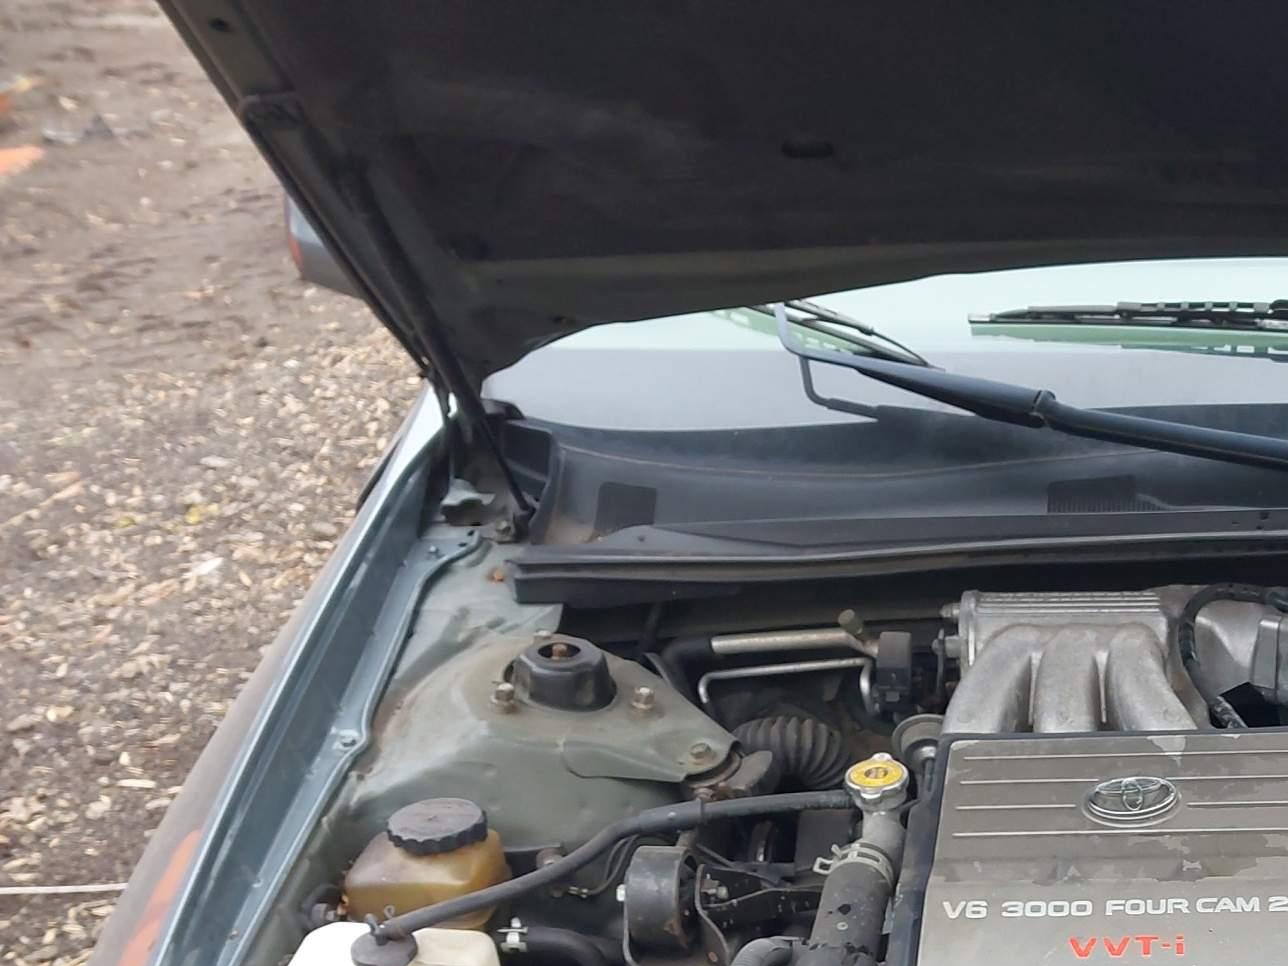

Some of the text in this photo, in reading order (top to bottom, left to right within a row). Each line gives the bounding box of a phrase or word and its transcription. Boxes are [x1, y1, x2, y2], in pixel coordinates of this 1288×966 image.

[943, 900, 988, 918] V6
[1001, 899, 1092, 917] 3000
[1104, 898, 1189, 916] FOUR
[1196, 897, 1261, 914] CAM
[1069, 935, 1186, 958] VVT-i
